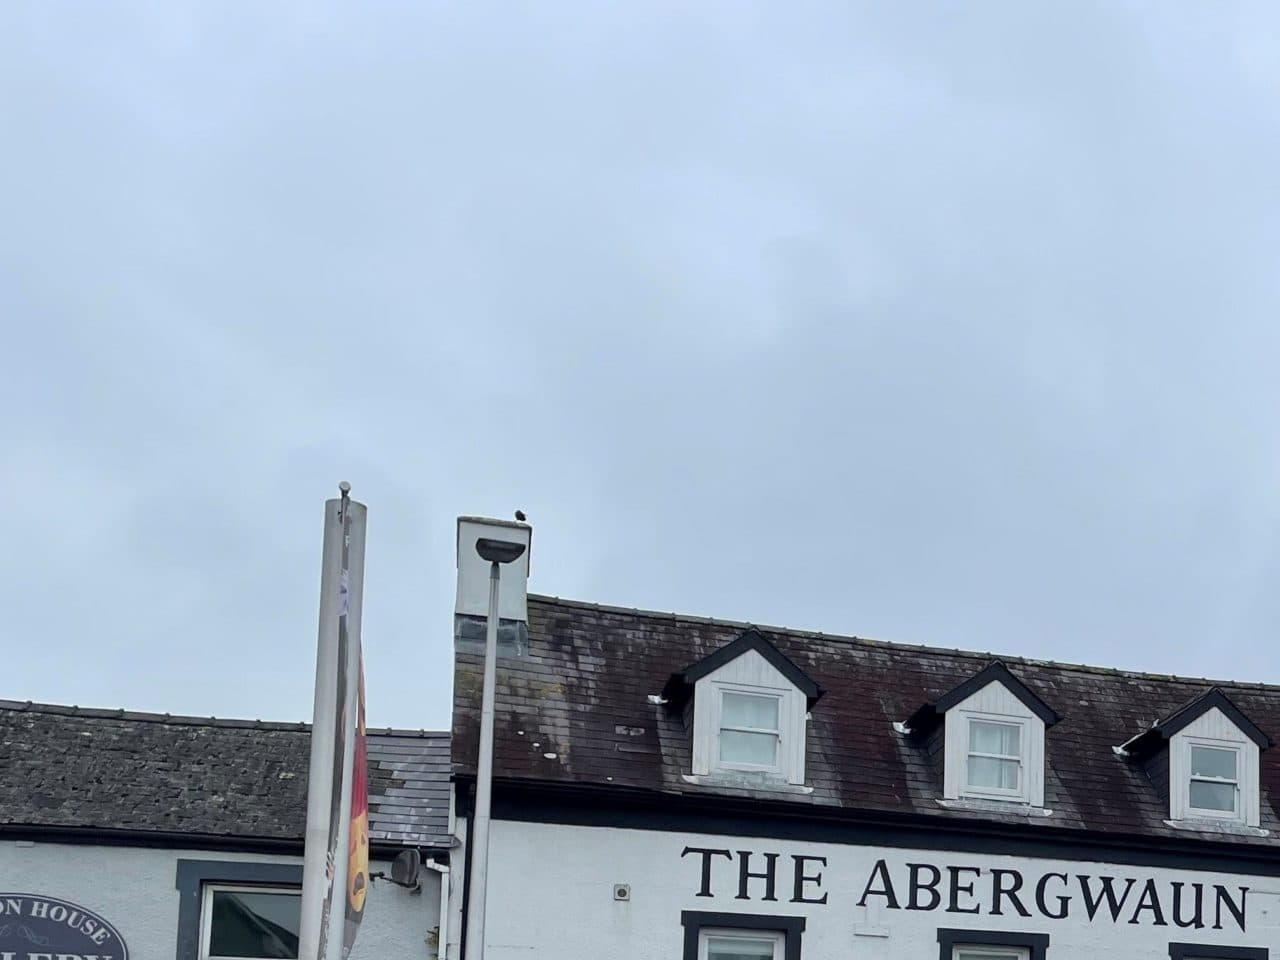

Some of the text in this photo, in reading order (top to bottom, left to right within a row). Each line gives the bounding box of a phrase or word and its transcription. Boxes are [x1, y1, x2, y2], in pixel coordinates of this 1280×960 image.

[30, 901, 111, 945] HOUSE
[680, 846, 829, 906] THE
[855, 859, 1250, 934] ABERGWAUN
